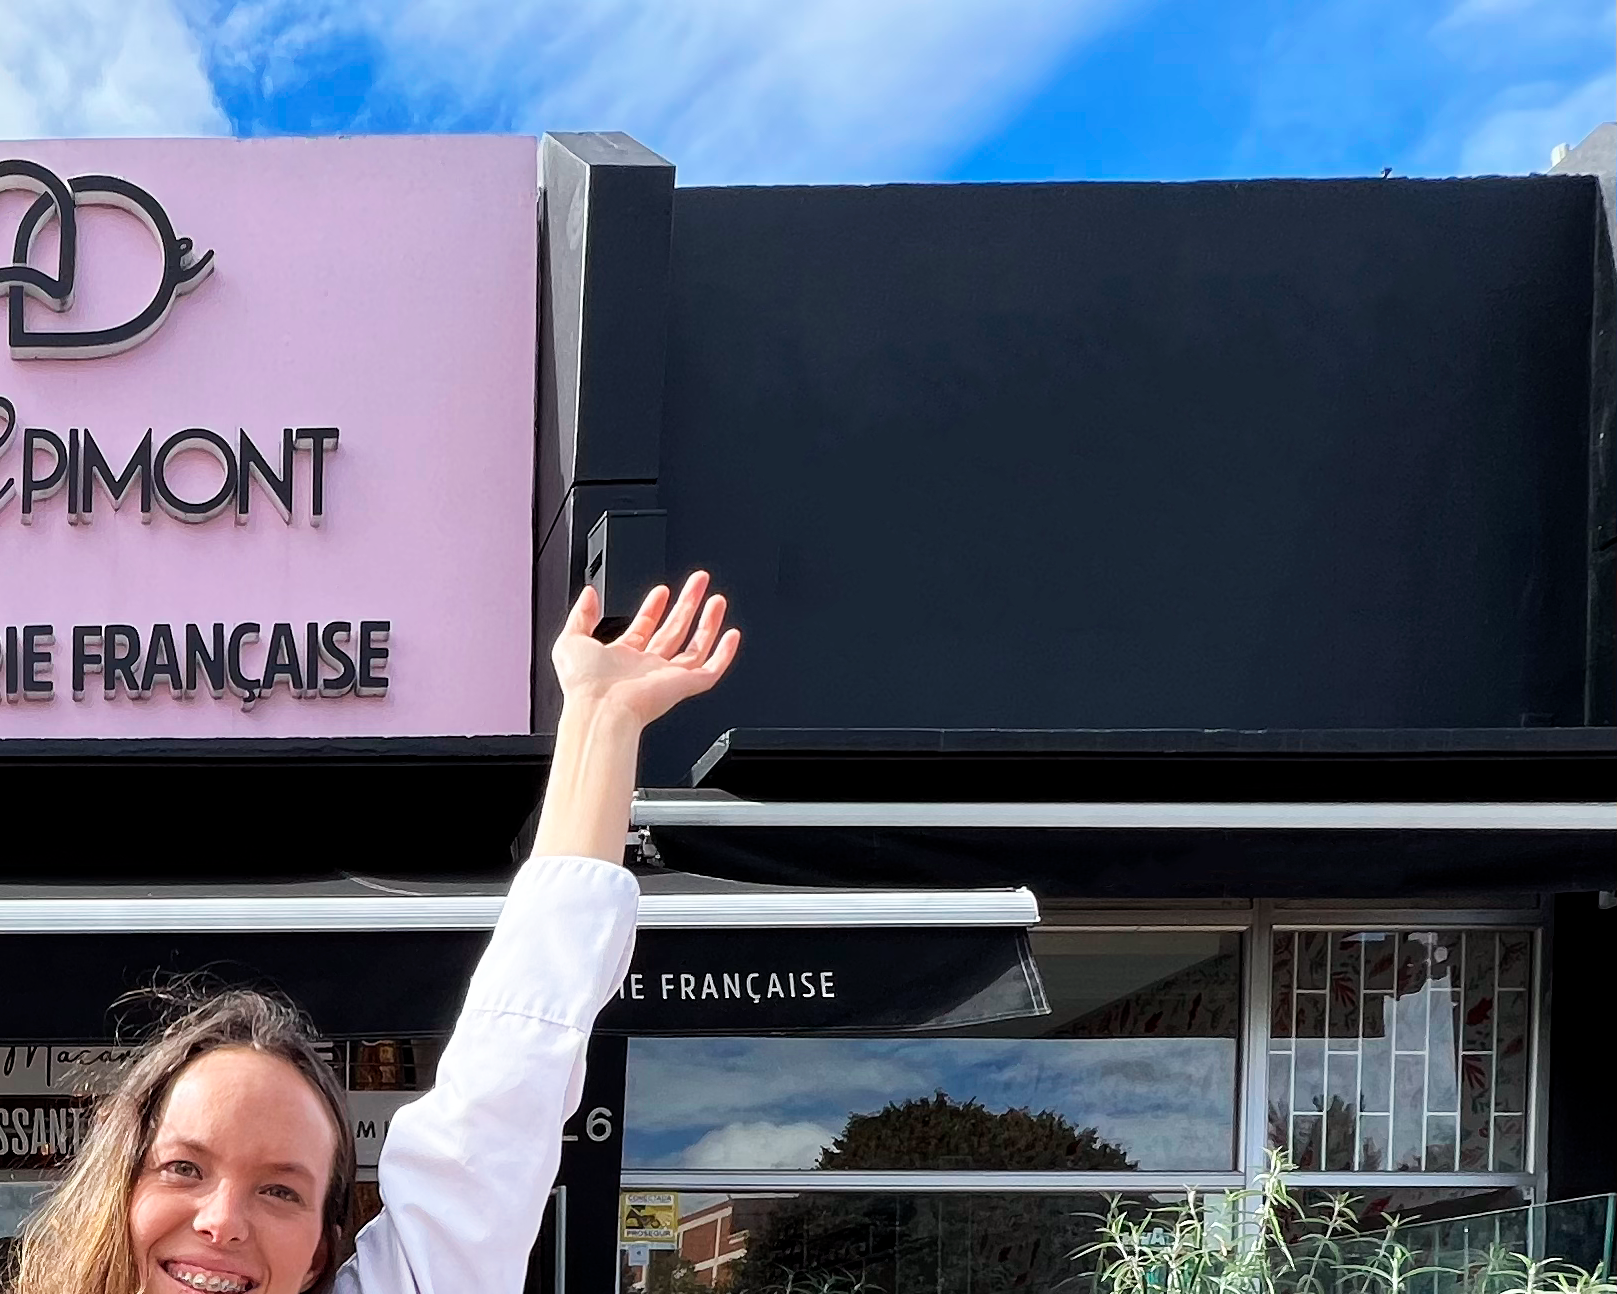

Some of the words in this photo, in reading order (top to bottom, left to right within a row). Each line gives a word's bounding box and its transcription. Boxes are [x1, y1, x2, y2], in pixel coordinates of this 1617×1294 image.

[22, 427, 339, 525] PIMONT
[72, 620, 391, 712] FRANÇAISE
[661, 972, 835, 1003] FRANÇAISE
